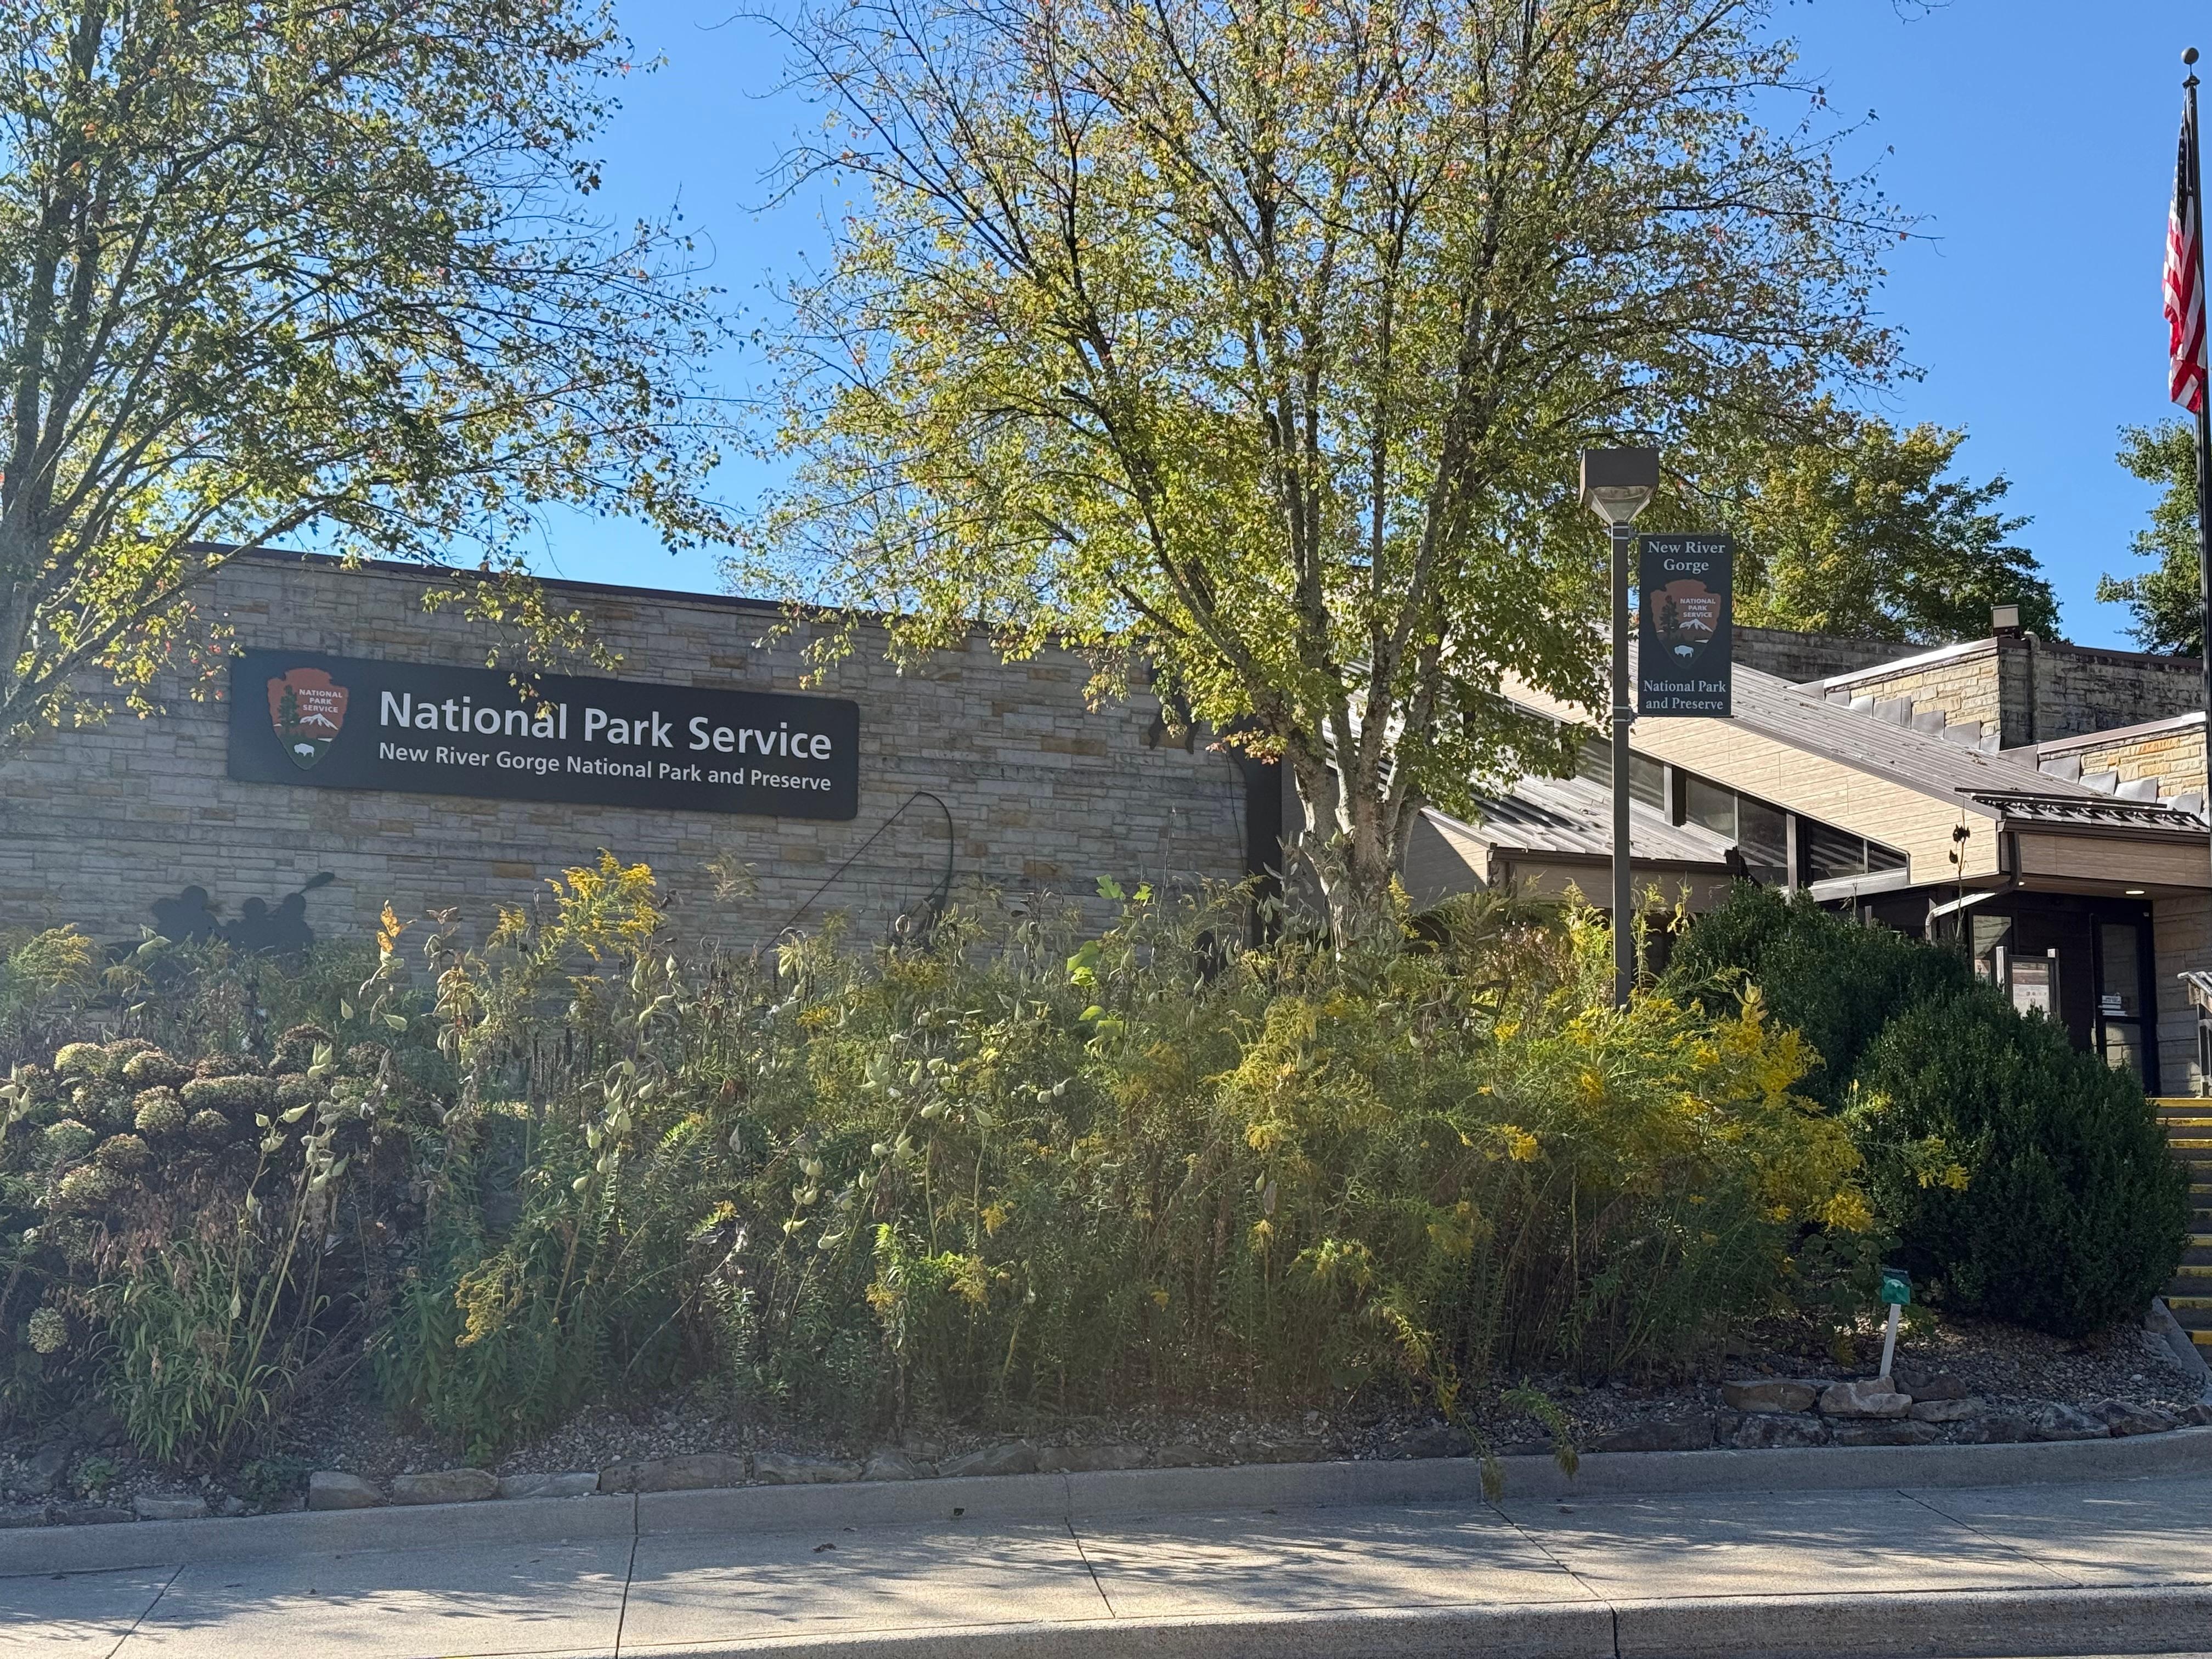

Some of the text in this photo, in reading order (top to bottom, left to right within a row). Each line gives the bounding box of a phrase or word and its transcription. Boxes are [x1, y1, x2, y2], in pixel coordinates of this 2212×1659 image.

[1648, 541, 1726, 554] New River
[1663, 558, 1709, 574] Gorge
[1643, 680, 1726, 693] National Park
[299, 689, 343, 698] NATIONAL
[302, 704, 338, 713] SERVICE
[1646, 697, 1724, 710] and Preserve
[380, 691, 832, 760] National Park Service
[379, 742, 832, 792] New River Gorge National Park and Preserve
